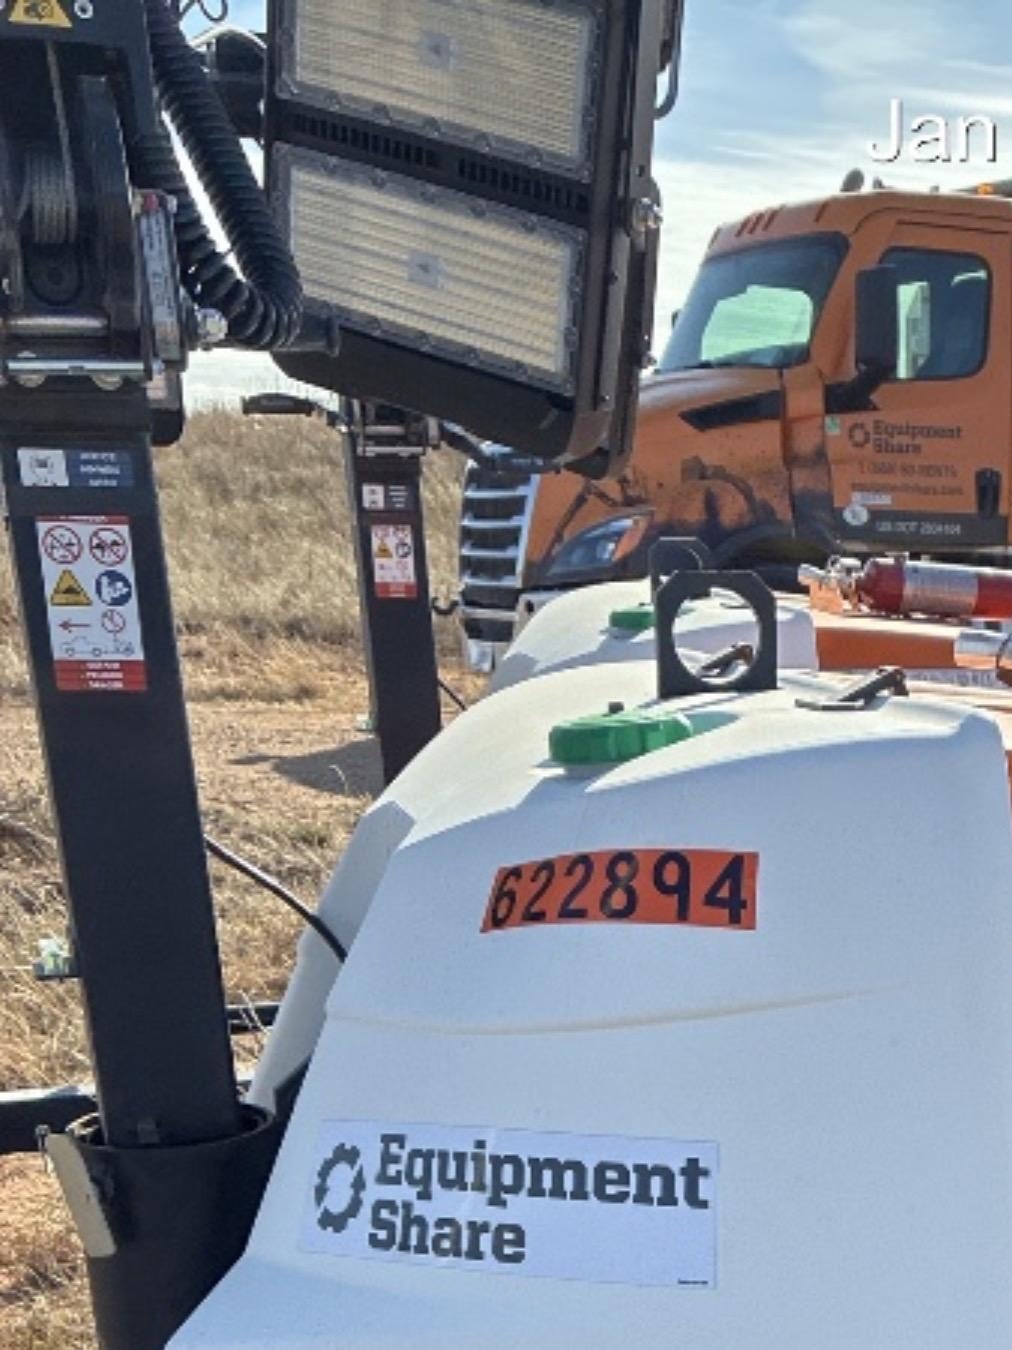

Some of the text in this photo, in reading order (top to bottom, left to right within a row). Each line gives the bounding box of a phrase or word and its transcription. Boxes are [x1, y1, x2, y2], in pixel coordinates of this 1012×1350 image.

[873, 420, 963, 441] Equipment
[873, 438, 922, 454] Share
[491, 851, 747, 927] 622894
[375, 1133, 710, 1209] Equipment
[368, 1199, 526, 1263] Share
